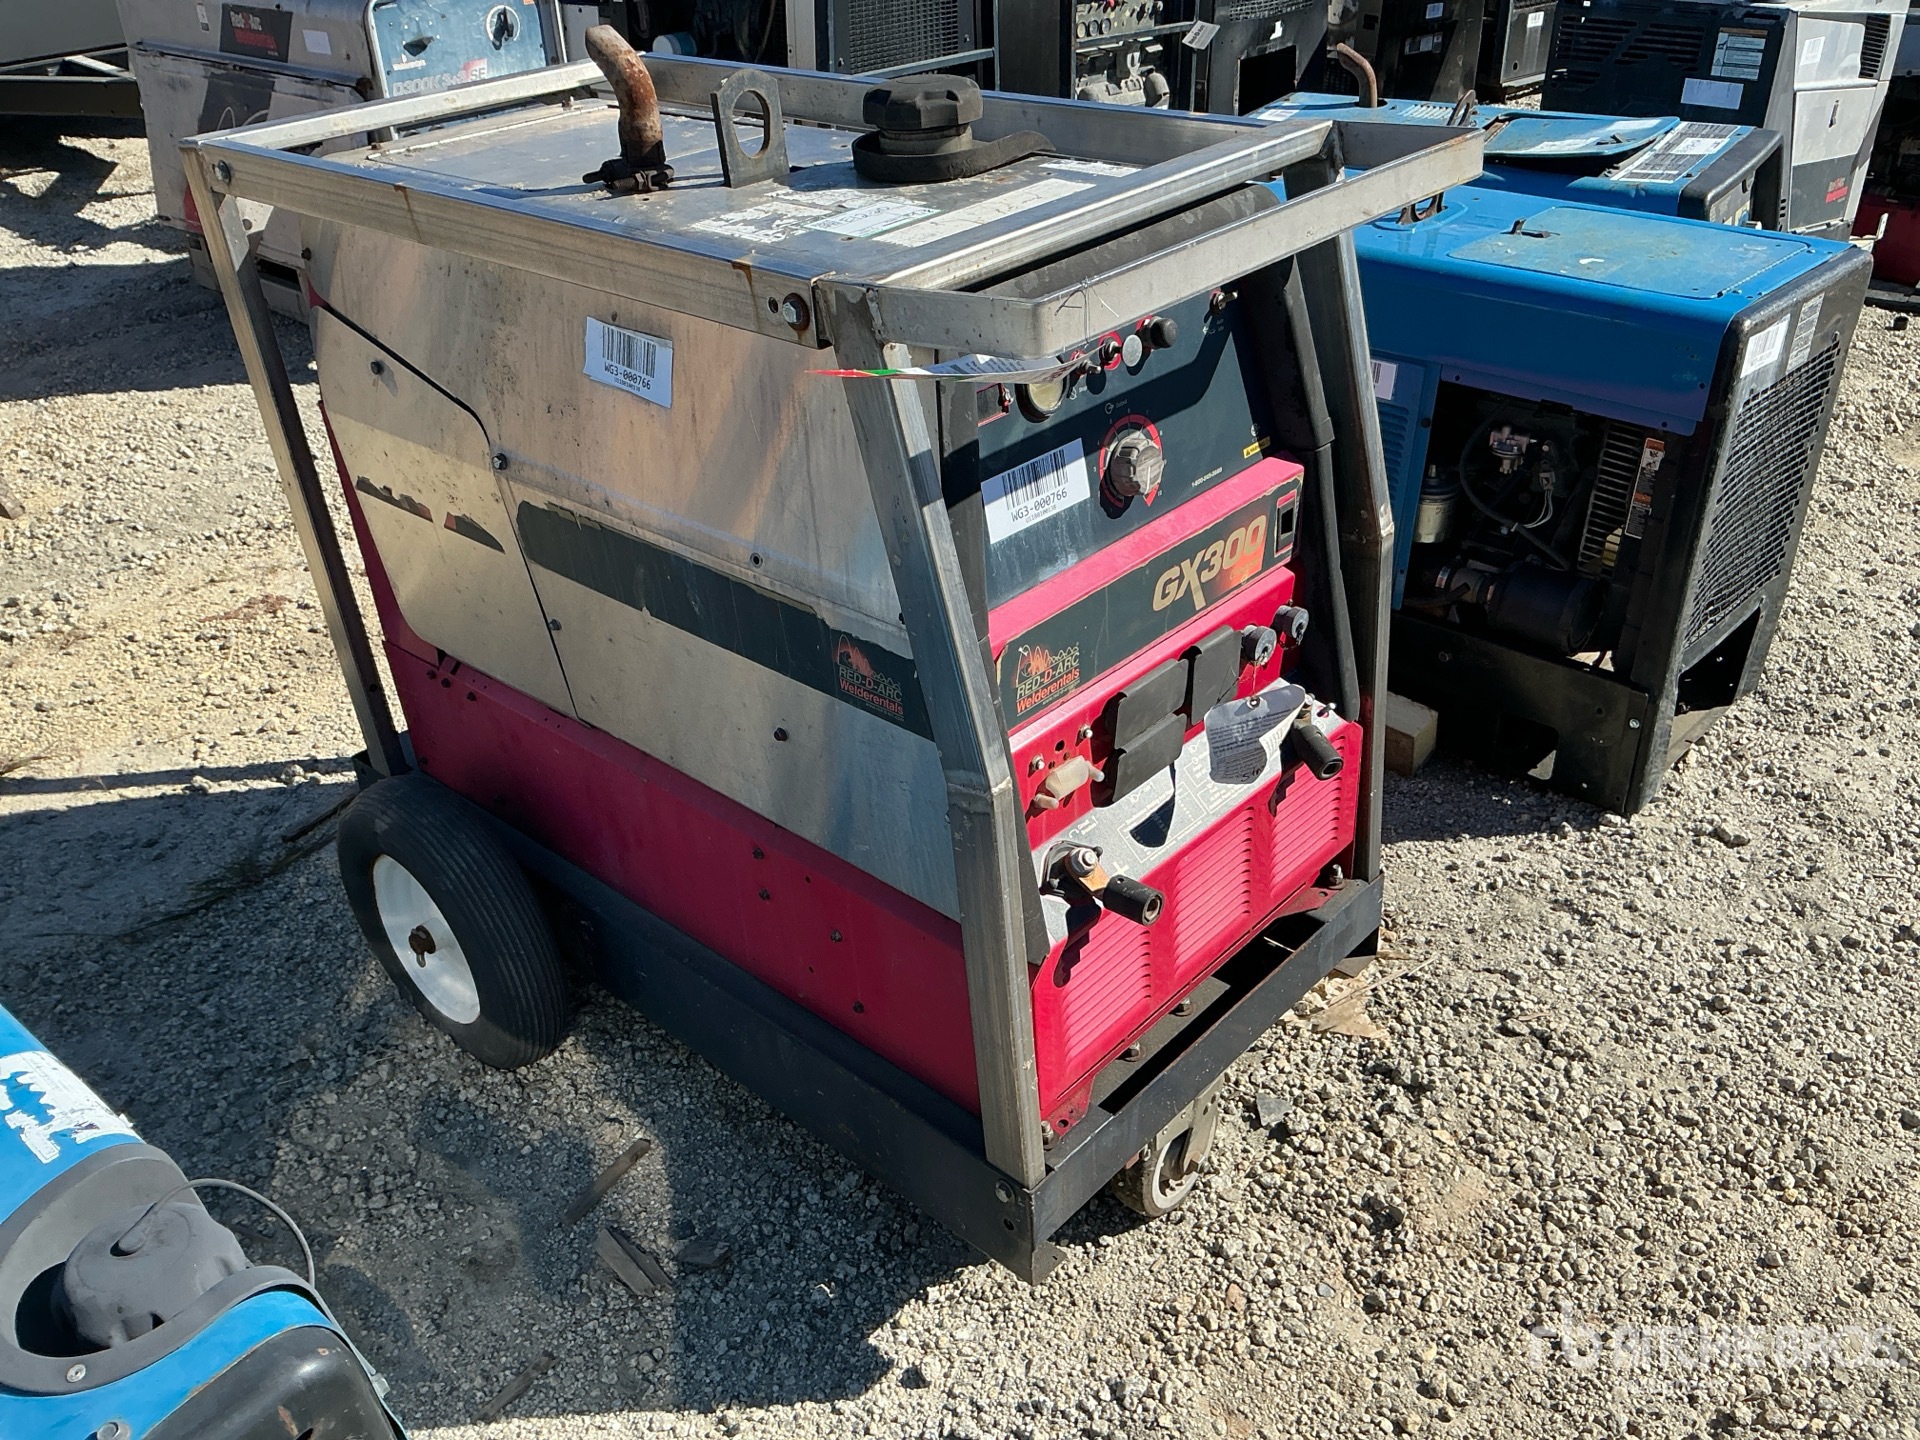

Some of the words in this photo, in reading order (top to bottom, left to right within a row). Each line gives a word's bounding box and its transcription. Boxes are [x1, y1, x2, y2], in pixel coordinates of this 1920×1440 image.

[393, 75, 441, 97] D300K
[470, 66, 486, 81] SE
[604, 361, 652, 391] WG3-000766
[1011, 488, 1068, 522] WG3-000766
[1152, 514, 1267, 612] GX300
[840, 667, 902, 701] RED-D-ARC
[1016, 668, 1080, 714] Welderentals
[1017, 652, 1080, 700] RED-D-ARC
[840, 679, 904, 715] Welderentals
